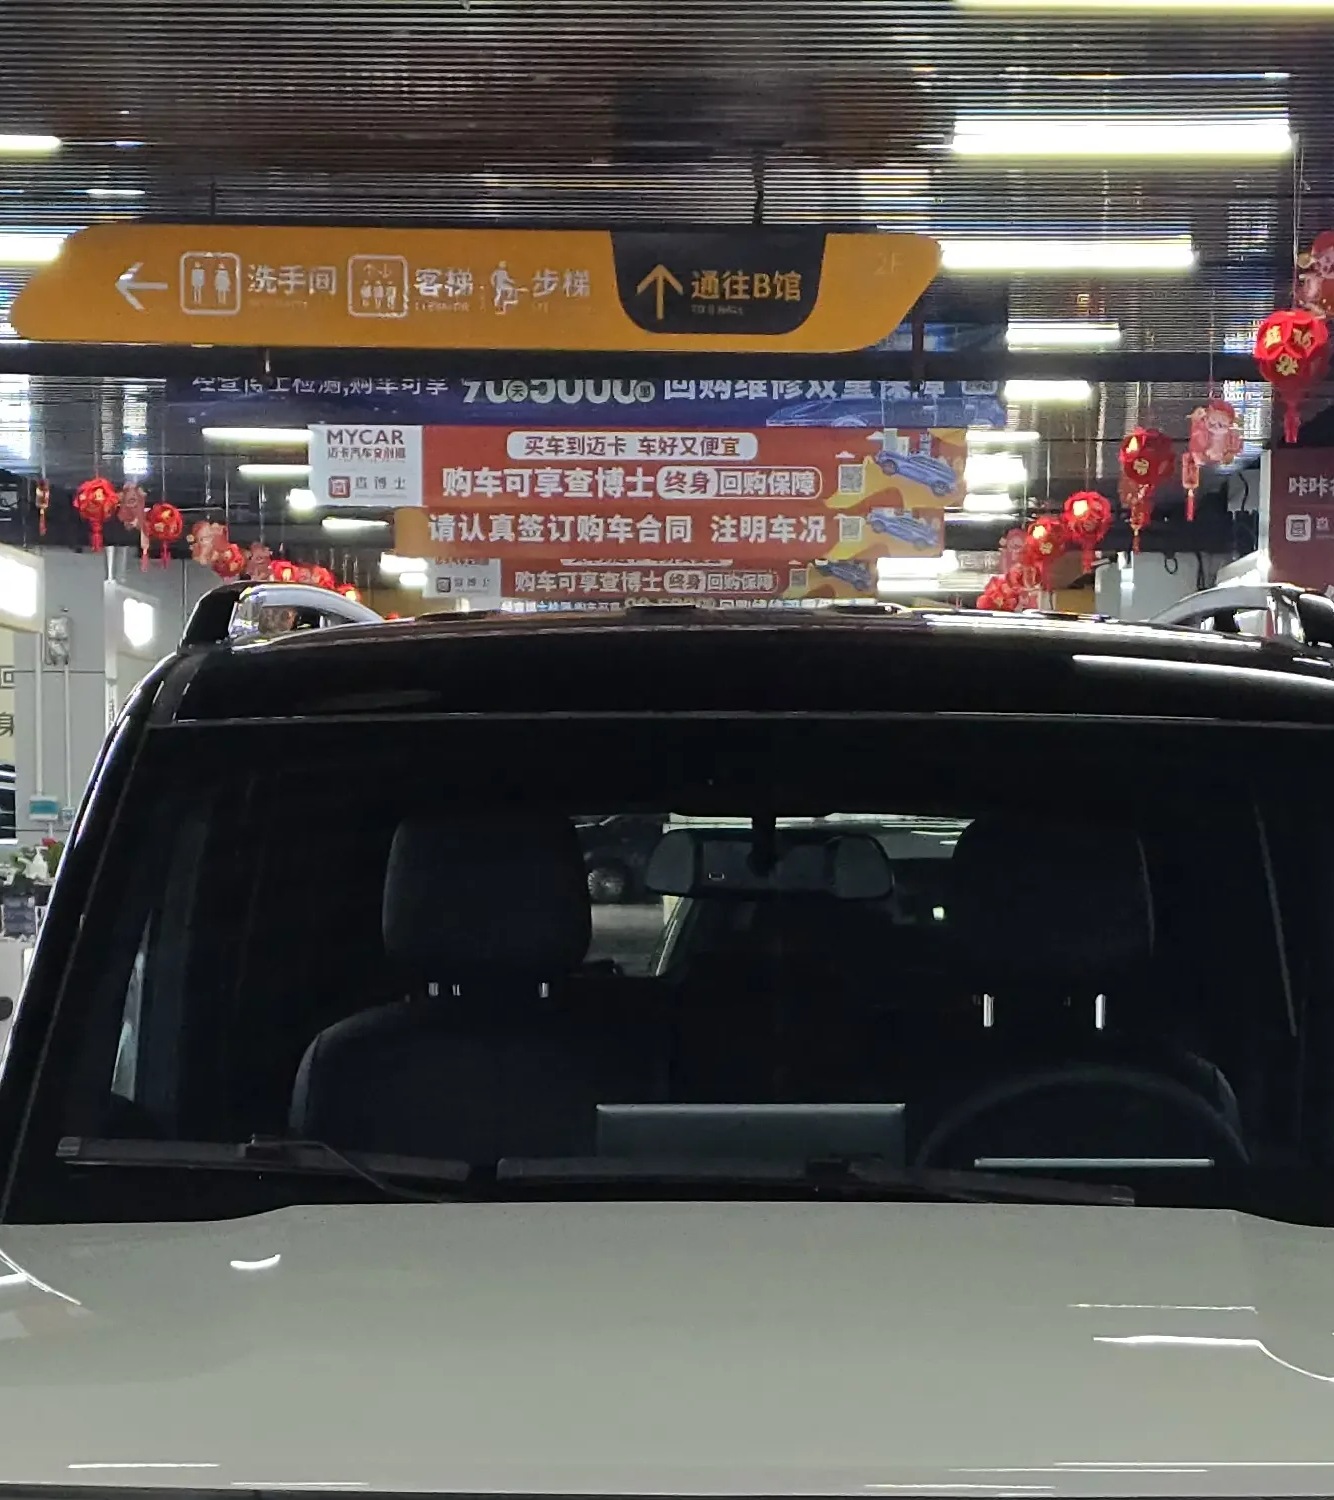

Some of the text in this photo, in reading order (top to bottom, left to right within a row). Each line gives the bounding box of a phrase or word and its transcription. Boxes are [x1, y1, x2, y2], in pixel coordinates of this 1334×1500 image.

[247, 264, 803, 301] 洗手间 客梯 步梯 通往B馆
[327, 429, 404, 445] MYCAR
[524, 435, 742, 457] 买车到迈卡 车好又便宜
[428, 512, 828, 545] 请认真签订购车合同 注明车况
